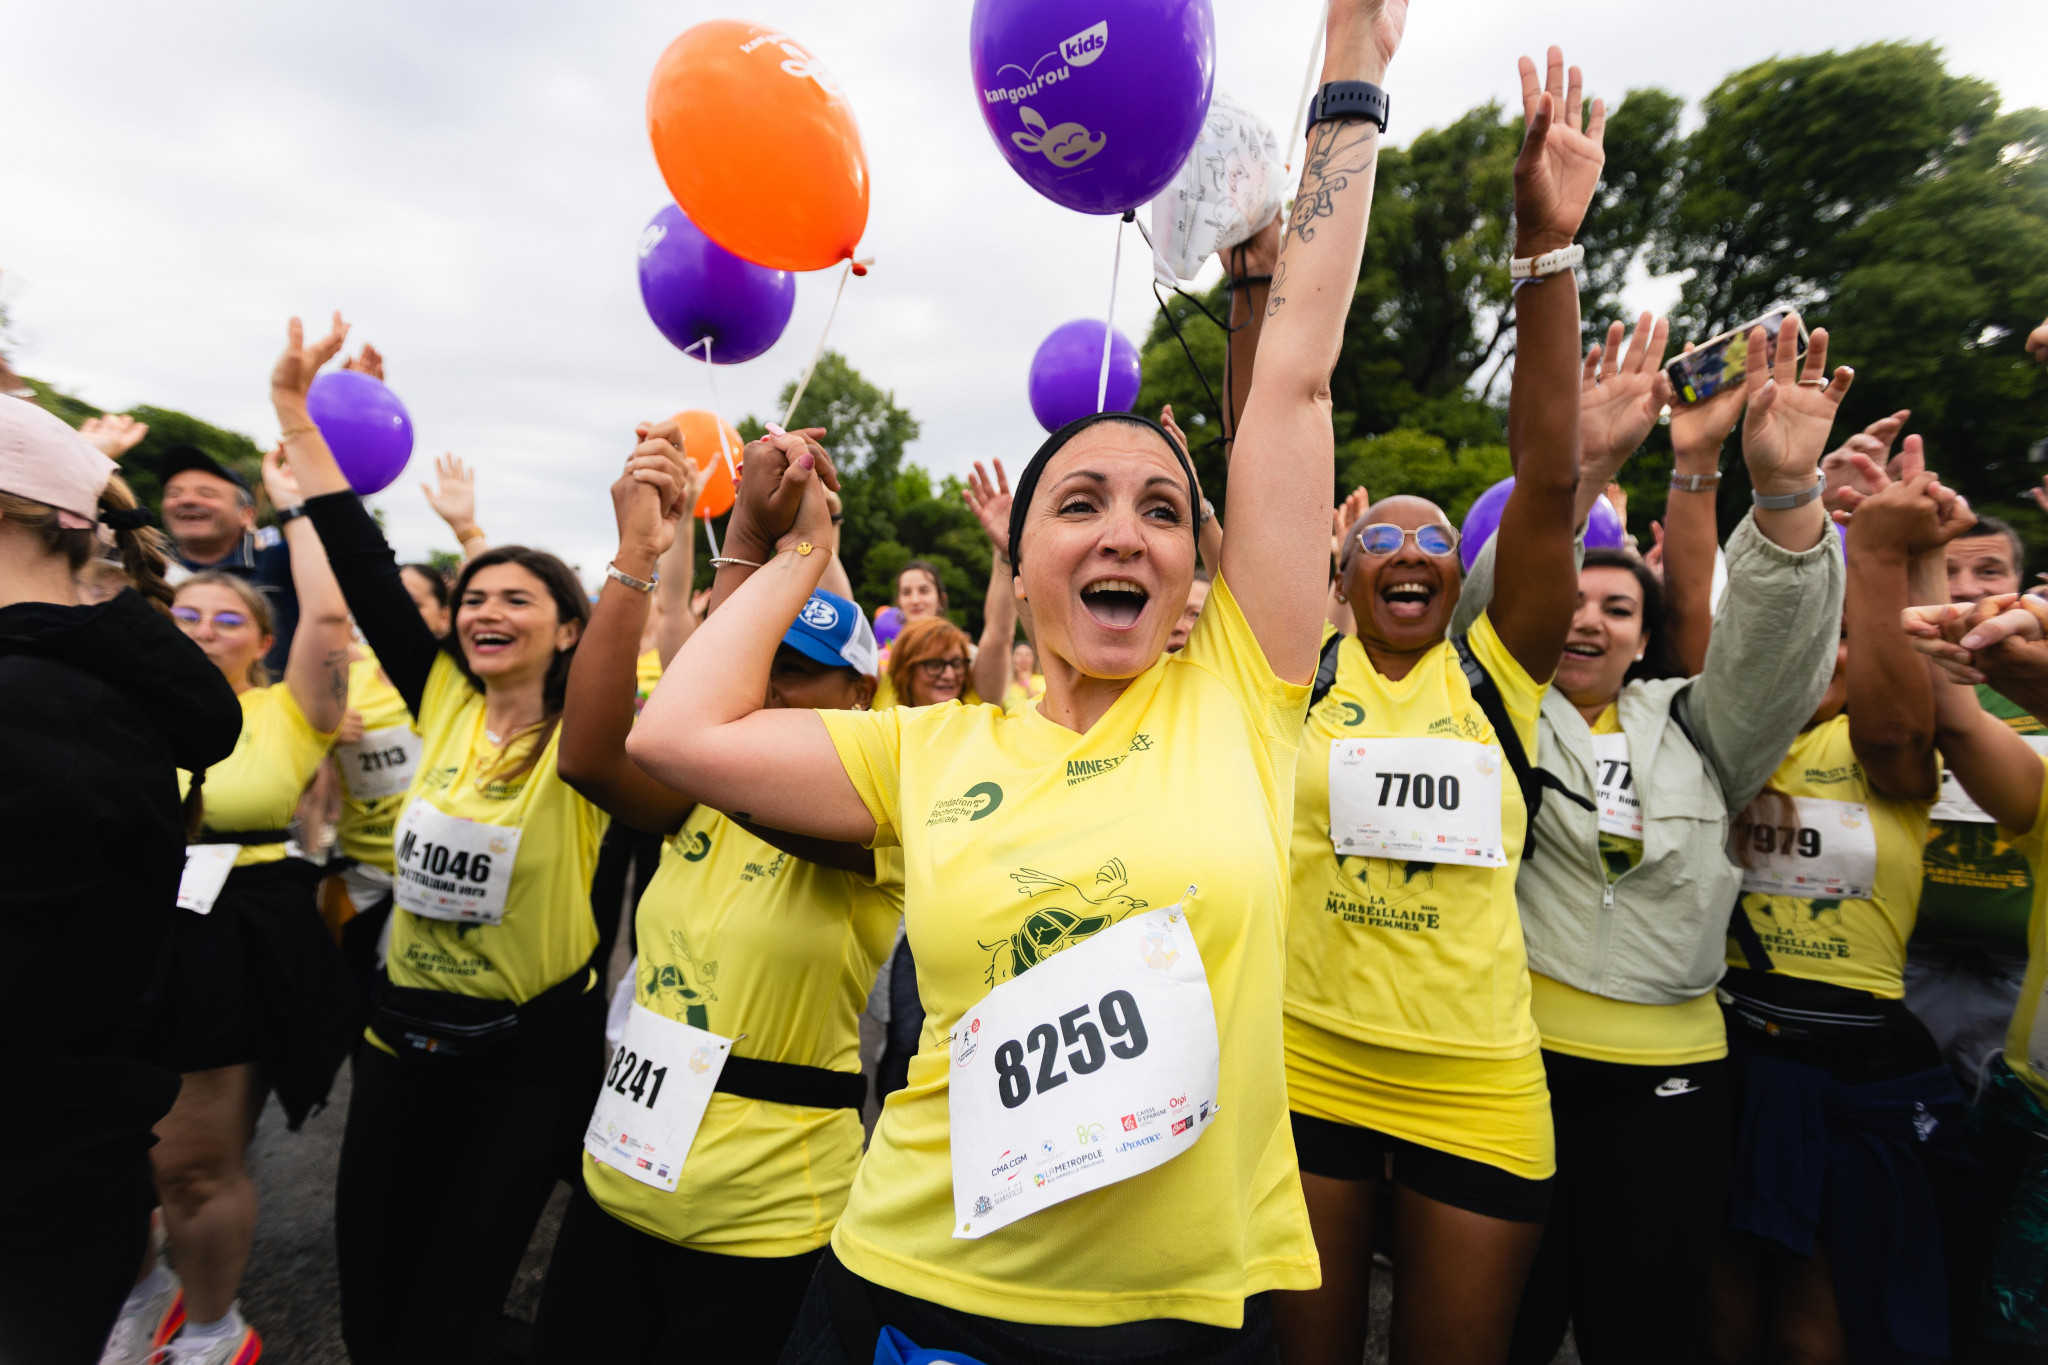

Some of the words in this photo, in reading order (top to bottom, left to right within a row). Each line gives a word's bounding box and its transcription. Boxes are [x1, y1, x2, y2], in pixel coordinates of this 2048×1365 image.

[1065, 33, 1104, 61] kids
[358, 746, 407, 772] 2113
[1596, 759, 1633, 790] 77
[934, 798, 973, 809] Fondation
[1375, 772, 1461, 811] 7700
[930, 808, 972, 818] Recherche
[1370, 896, 1386, 905] LA
[1325, 898, 1440, 929] MARSEILLAISE
[1343, 913, 1365, 925] DES
[1369, 918, 1420, 932] FEMMES
[994, 990, 1148, 1108] 8259
[607, 1045, 668, 1109] 8241
[1136, 1106, 1155, 1117] CAISSE
[1170, 1092, 1186, 1107] Orpi
[991, 1163, 1009, 1177] CMA
[1009, 1153, 1028, 1169] CGM
[994, 1186, 1024, 1205] MARSEILLE
